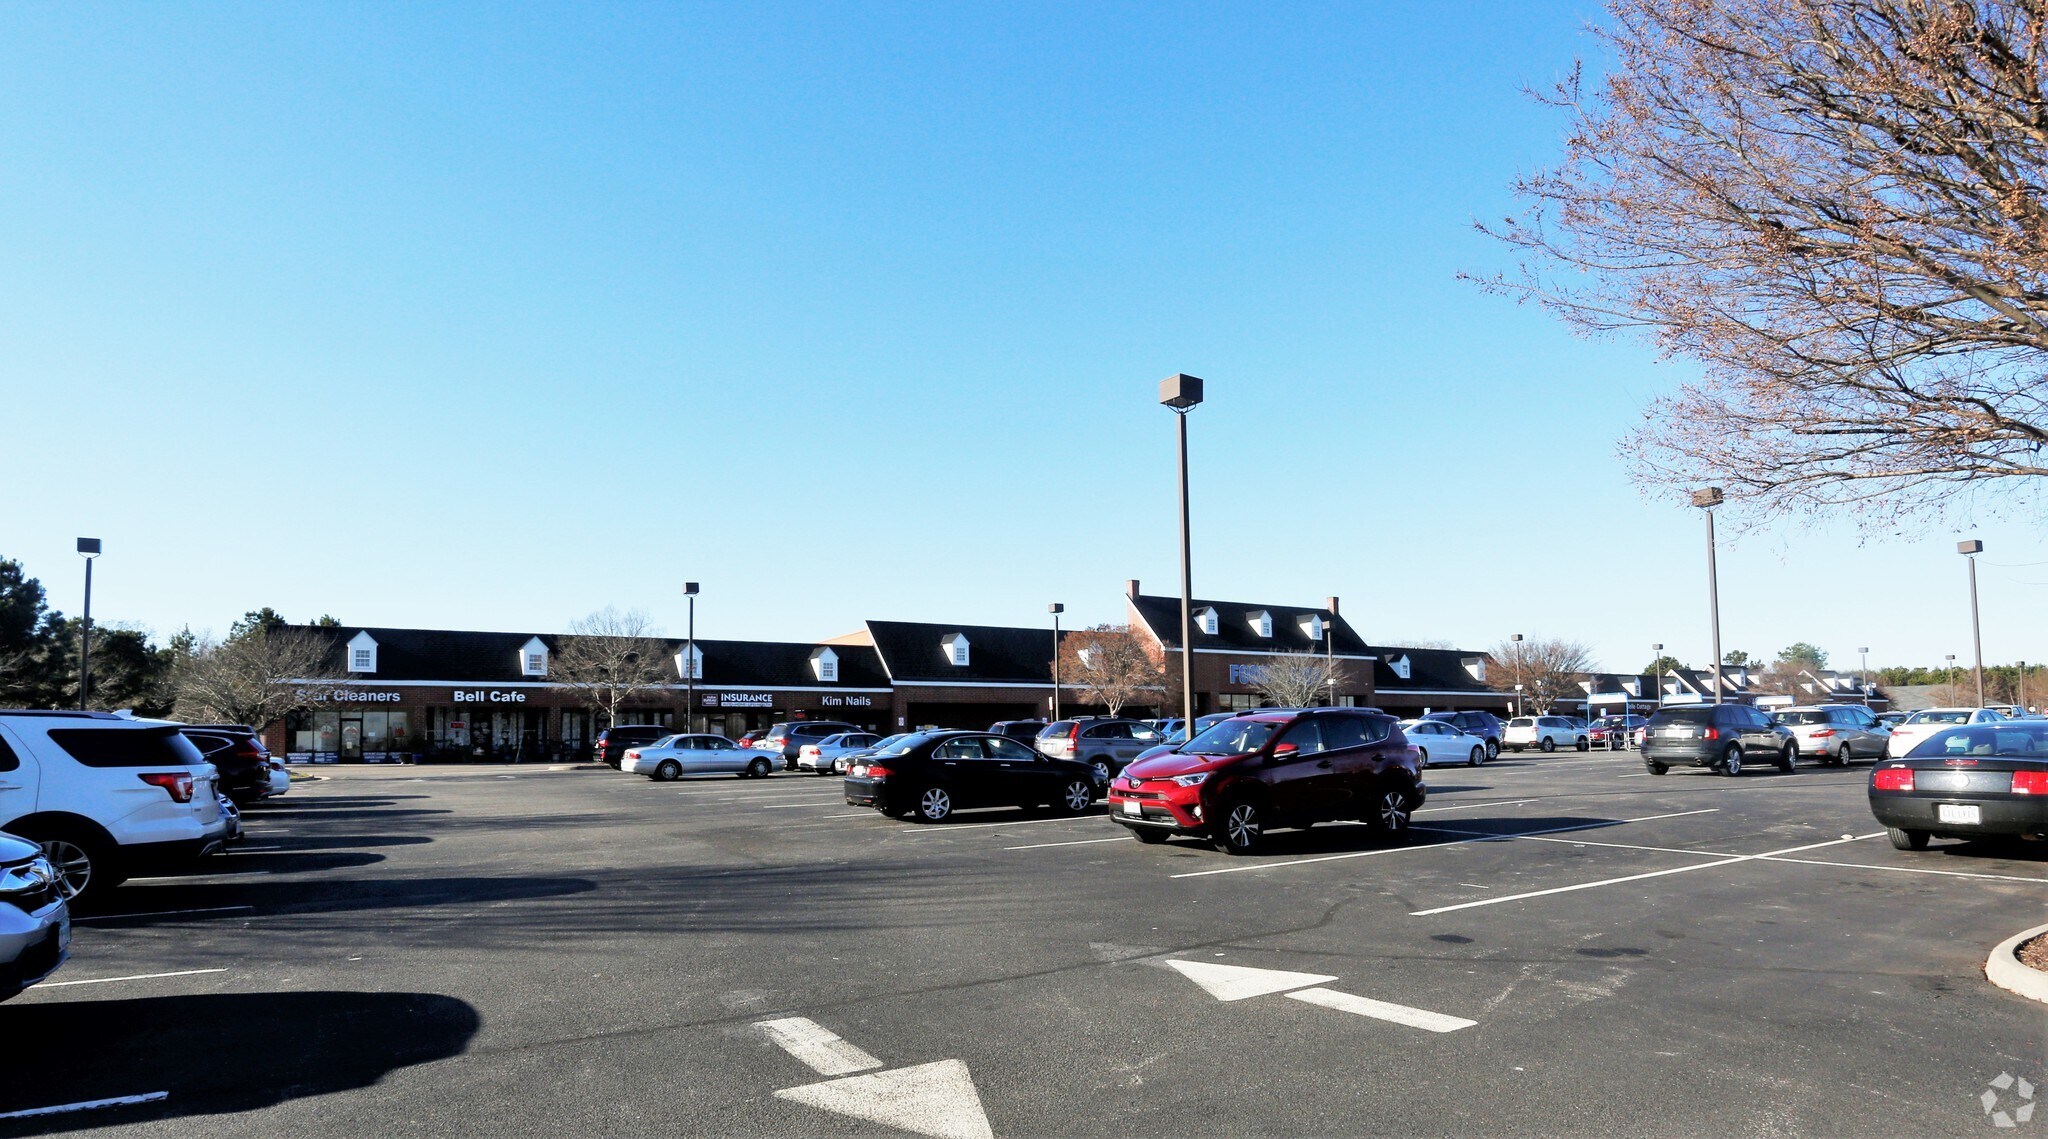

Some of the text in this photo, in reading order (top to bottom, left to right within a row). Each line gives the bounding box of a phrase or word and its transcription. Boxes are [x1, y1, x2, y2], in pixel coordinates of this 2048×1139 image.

[333, 689, 401, 702] Cleaners
[453, 690, 526, 702] Bell Cafe
[720, 693, 773, 702] INSURANCE
[822, 696, 871, 706] Kim Nails
